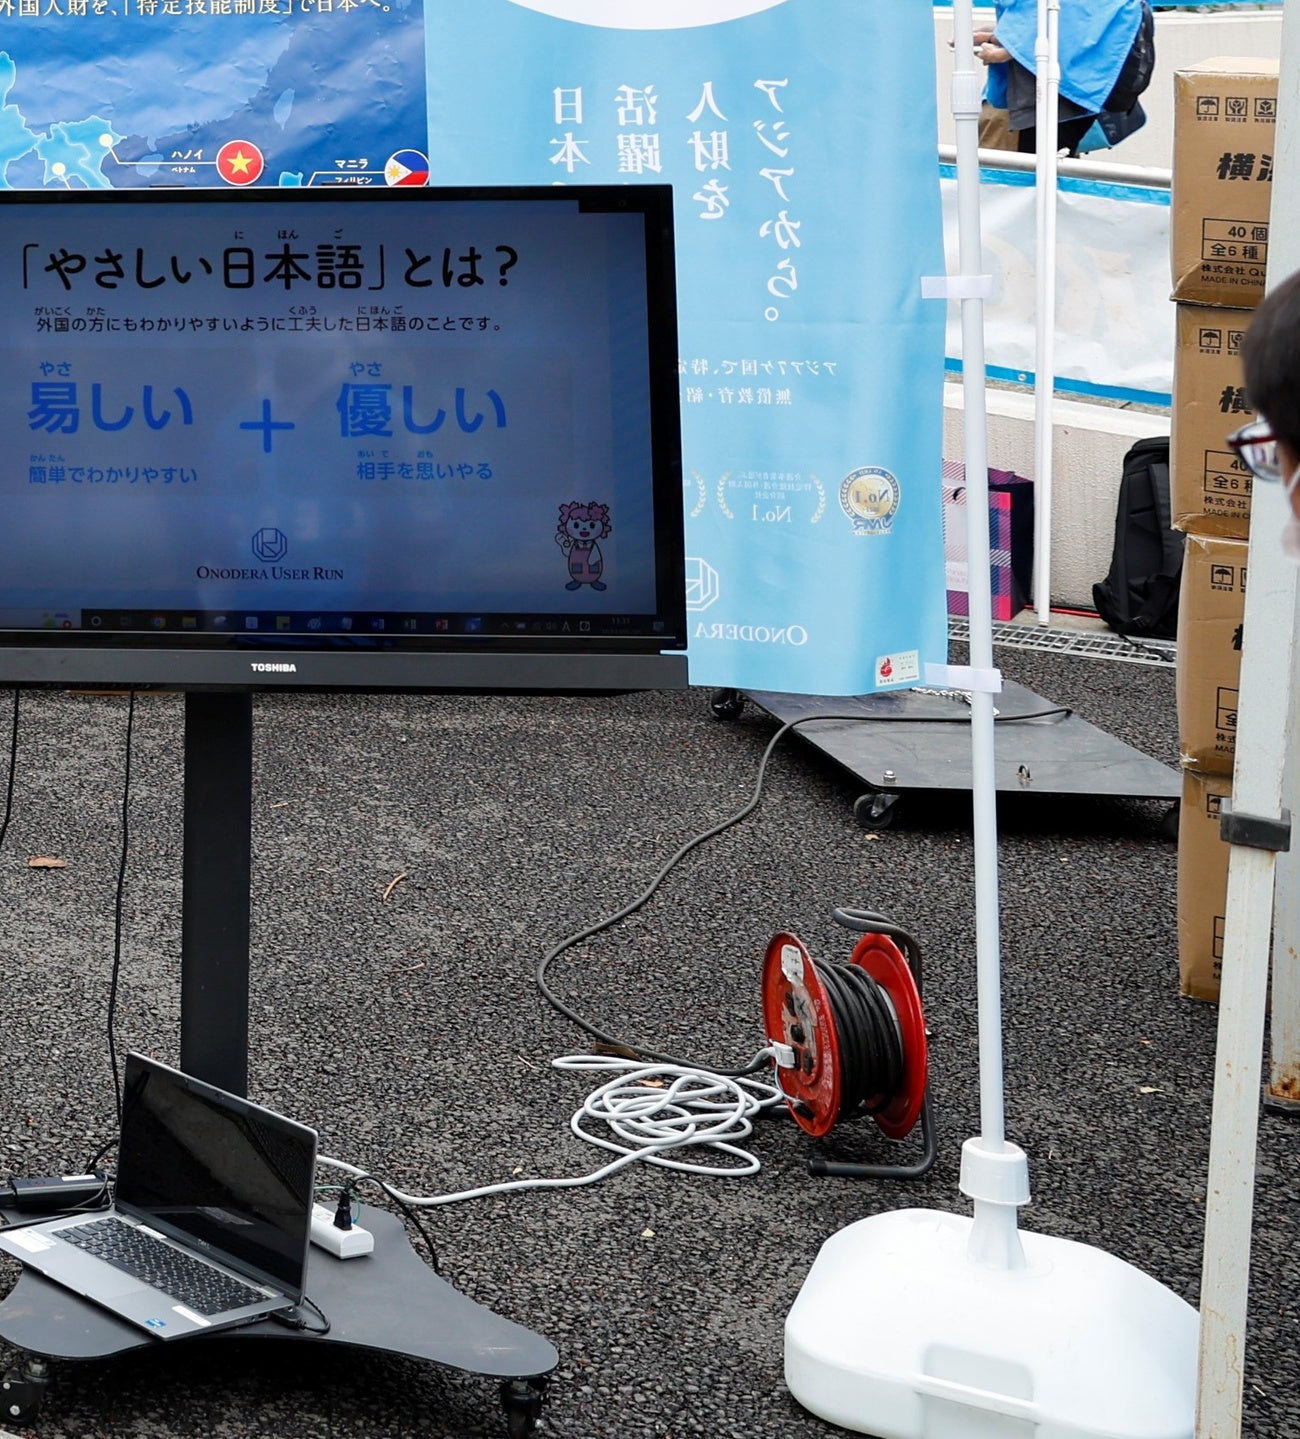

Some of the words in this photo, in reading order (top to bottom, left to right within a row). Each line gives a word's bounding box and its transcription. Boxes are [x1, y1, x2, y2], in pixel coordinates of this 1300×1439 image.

[172, 148, 204, 160] ハノイ
[335, 158, 370, 169] マニラ
[1228, 226, 1246, 238] 40
[22, 242, 518, 291] 「やさしい日本語」とは?
[1202, 263, 1245, 276] 株式会社
[1201, 275, 1227, 284] MADE
[36, 316, 502, 333] 外国の方にもわかりやすいように工夫した日本語のことです。
[39, 361, 72, 377] やさ
[349, 361, 383, 377] やさ
[26, 381, 193, 434] 易しい
[336, 382, 507, 438] 優しい
[28, 465, 198, 485] 簡単でわかりやすい
[356, 462, 494, 482] 相手を思いやる
[1204, 496, 1246, 509] 株式会社
[1203, 507, 1229, 517] MADE
[196, 565, 268, 580] ONODERA
[271, 566, 310, 580] USER
[313, 566, 344, 580] RUN
[251, 663, 297, 673] TOSHIBA
